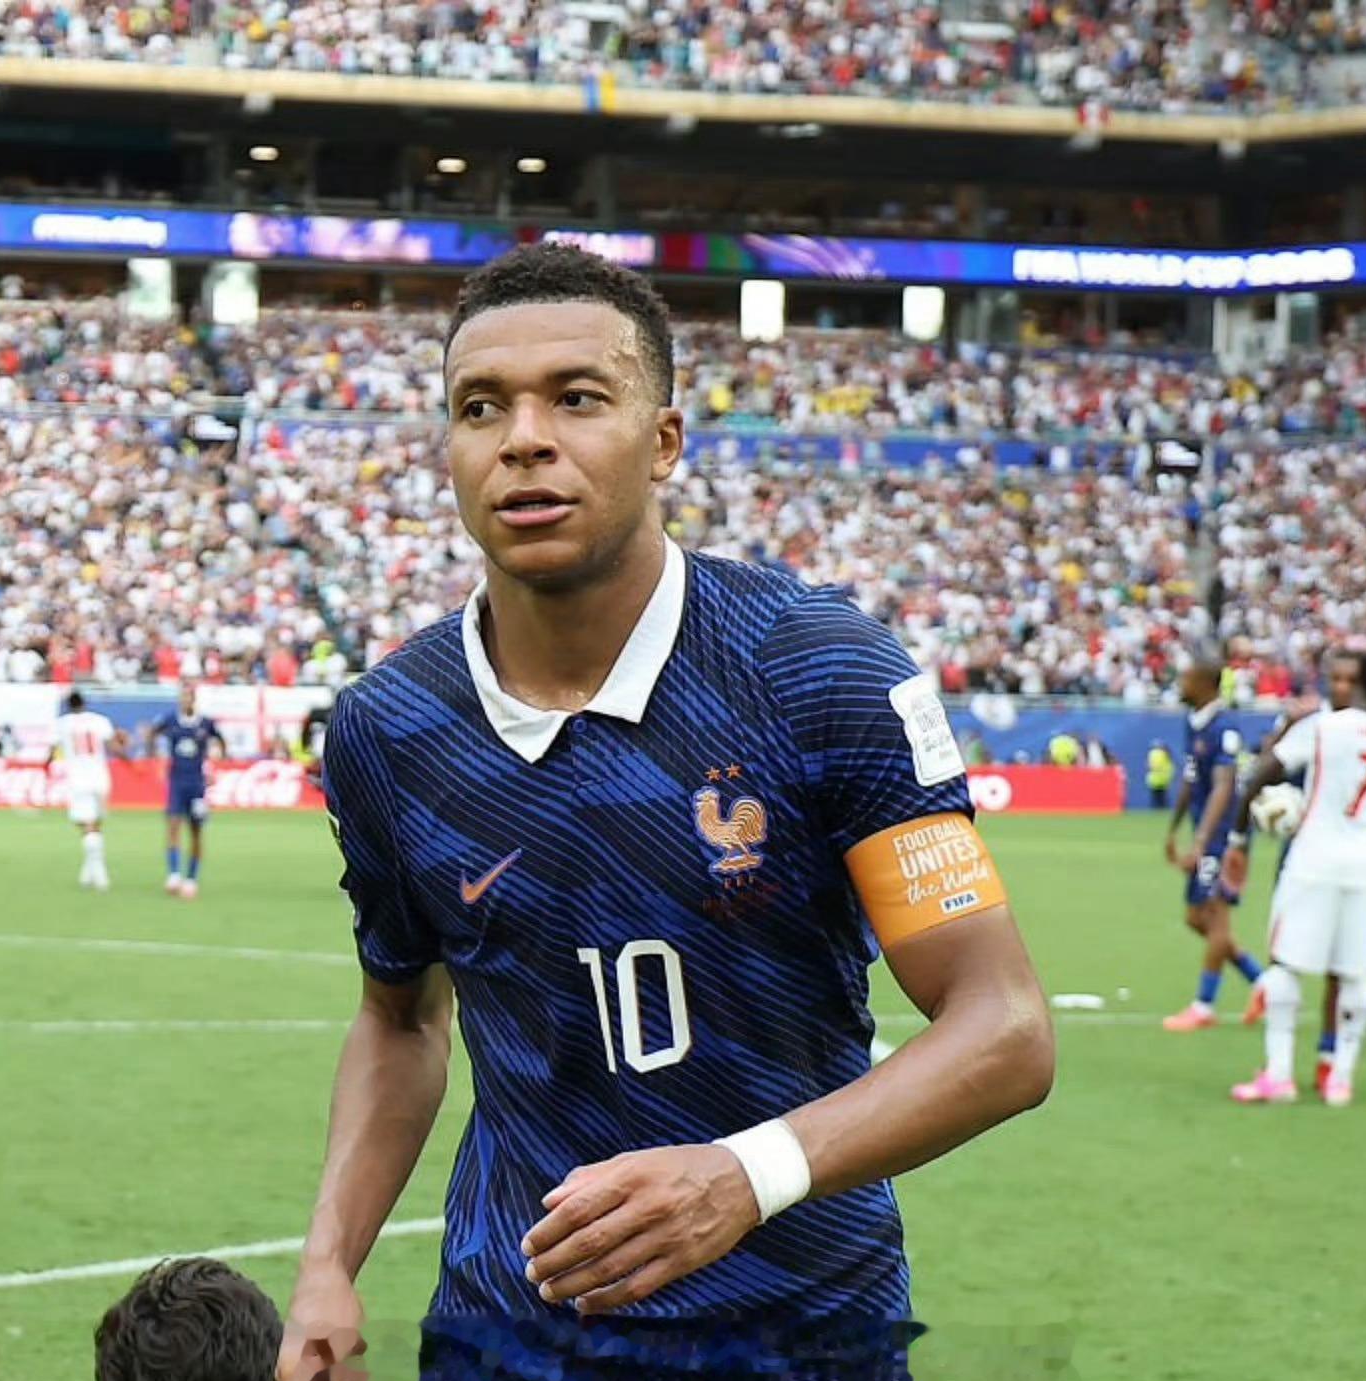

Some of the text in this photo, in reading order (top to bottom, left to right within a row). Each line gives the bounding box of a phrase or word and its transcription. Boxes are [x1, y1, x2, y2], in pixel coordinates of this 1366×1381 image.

[893, 819, 964, 855] FOOTBALL
[900, 836, 978, 880] UNITES
[908, 861, 989, 906] the World
[944, 894, 975, 911] FIFA
[577, 939, 692, 1075] 10
